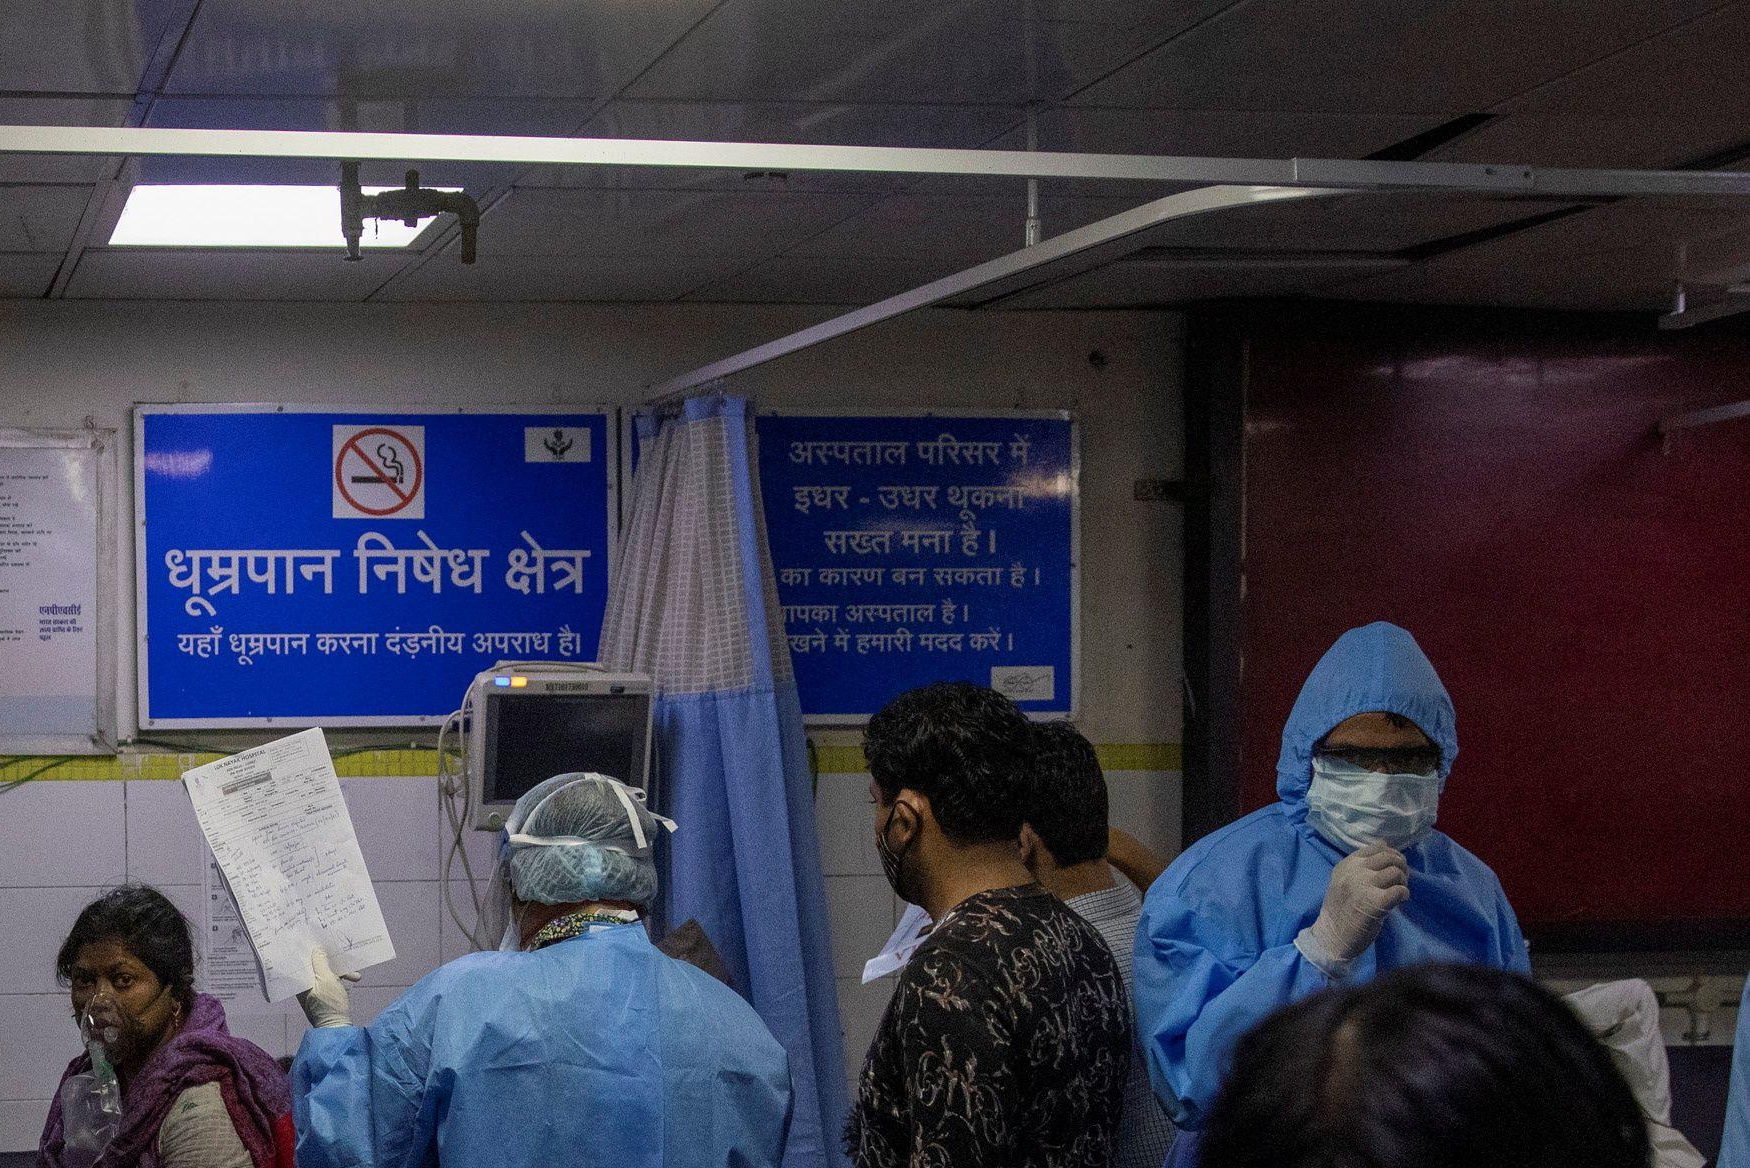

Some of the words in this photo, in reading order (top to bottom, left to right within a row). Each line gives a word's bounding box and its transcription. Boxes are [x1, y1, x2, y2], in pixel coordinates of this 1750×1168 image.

[789, 441, 910, 464] अस्पताल
[918, 434, 1001, 464] परिसर
[1010, 434, 1030, 466] में
[793, 486, 851, 514] इधर
[878, 486, 939, 509] उधर
[948, 487, 1026, 522] थूकना
[824, 530, 896, 554] सख्त
[900, 530, 954, 553] मना
[165, 549, 340, 616] धूम्रपान
[353, 531, 490, 593] निषेध
[506, 531, 591, 594] क्षेत्र
[819, 568, 886, 585] कारण
[892, 568, 927, 585] बन
[934, 568, 1003, 585] सकता
[846, 604, 936, 622] अस्पताल
[178, 625, 224, 658] यहाँ
[229, 634, 310, 665] धूम्रपान
[316, 633, 380, 654] करना
[473, 632, 552, 653] अपराध
[558, 625, 580, 656] है।
[790, 629, 827, 651] खने
[834, 628, 851, 651] में
[856, 628, 913, 654] हमारी
[919, 634, 965, 651] मदद
